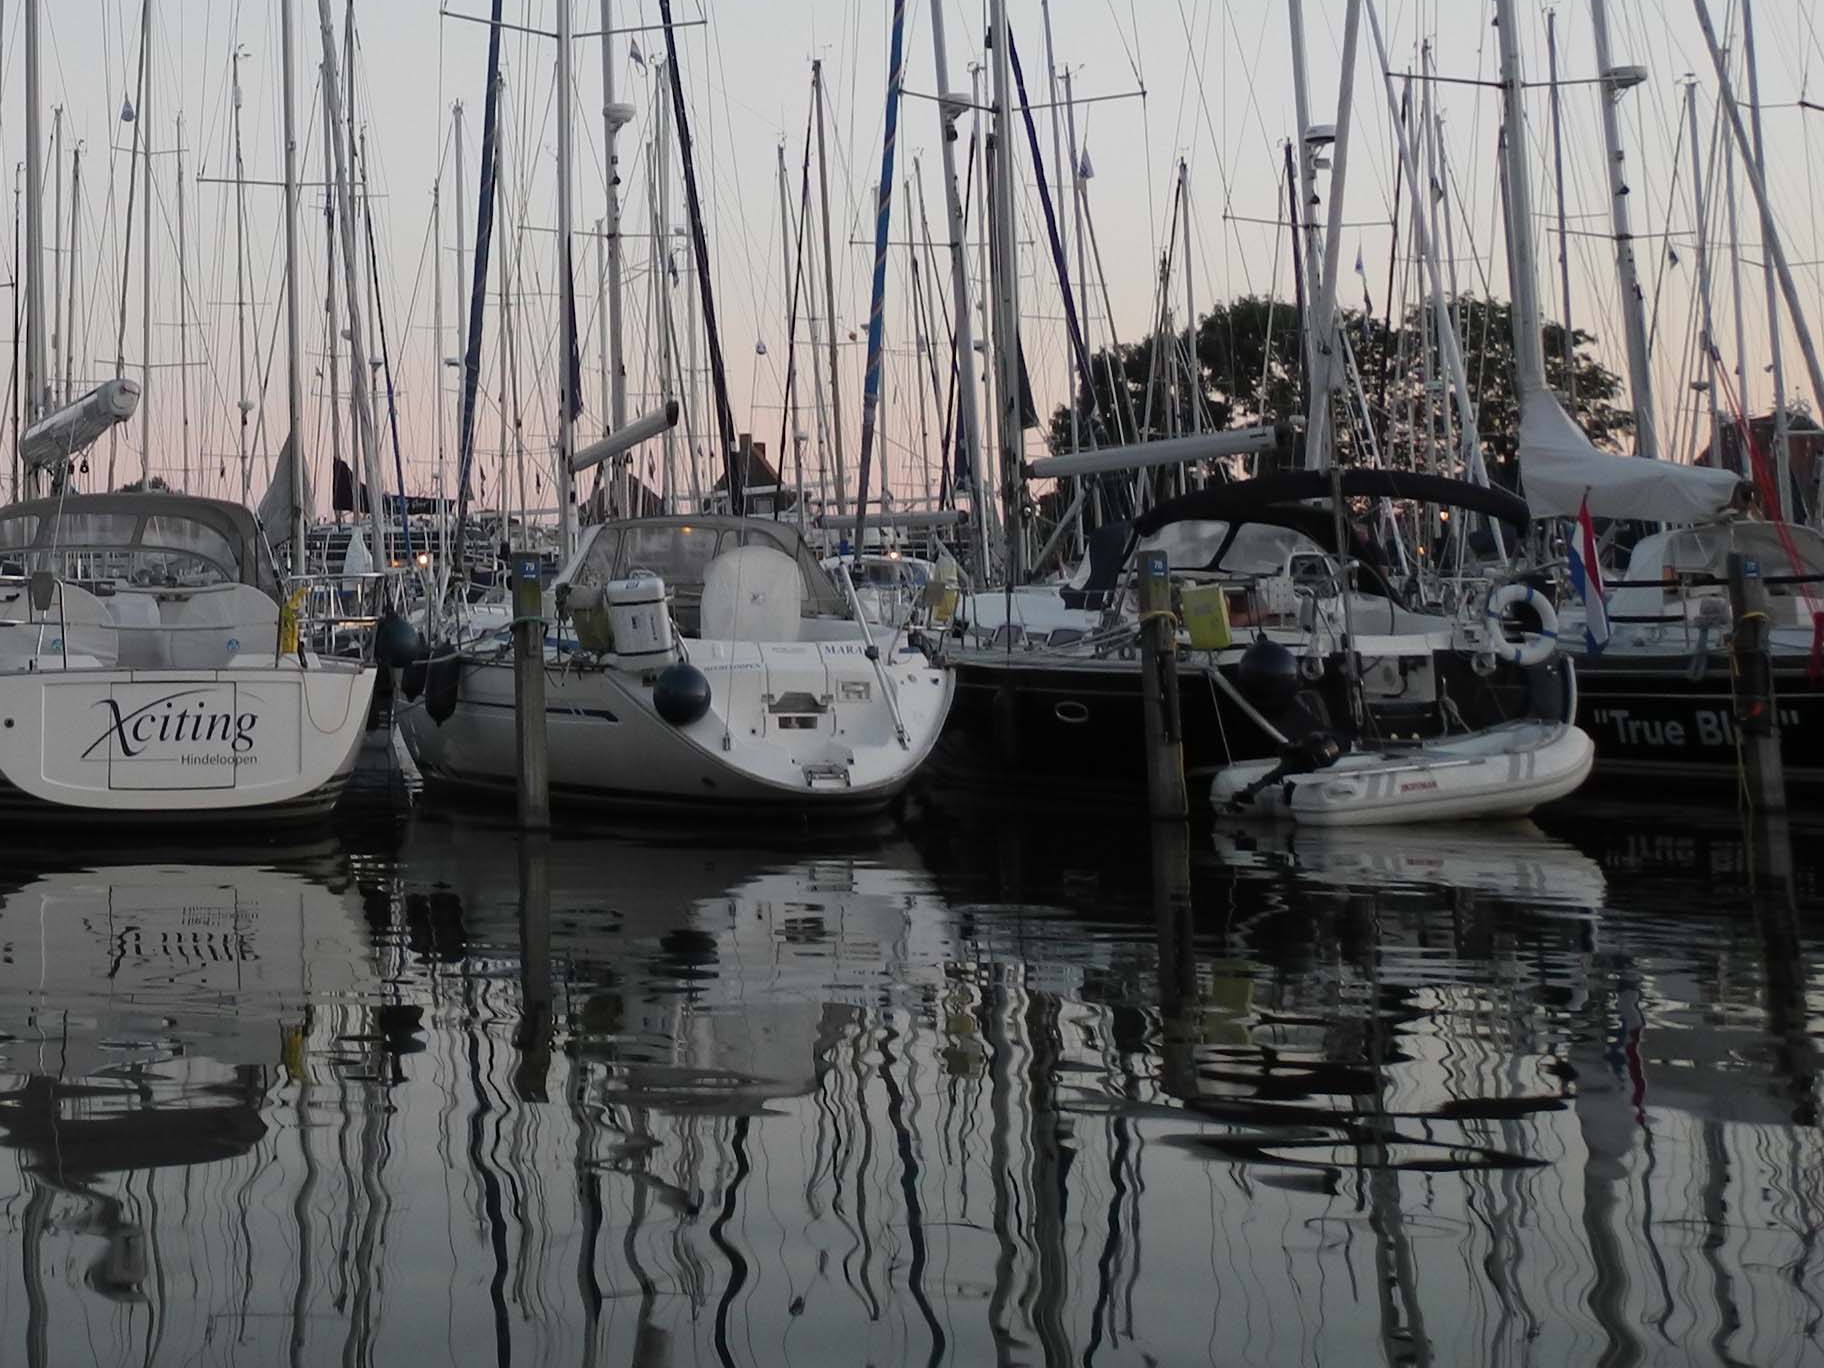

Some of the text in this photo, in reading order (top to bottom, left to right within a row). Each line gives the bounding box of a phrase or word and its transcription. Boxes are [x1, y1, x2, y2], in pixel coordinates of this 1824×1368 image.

[81, 688, 259, 758] Xciting
[1593, 708, 1800, 747] "True Bl"
[180, 754, 258, 767] Hindeloopen
